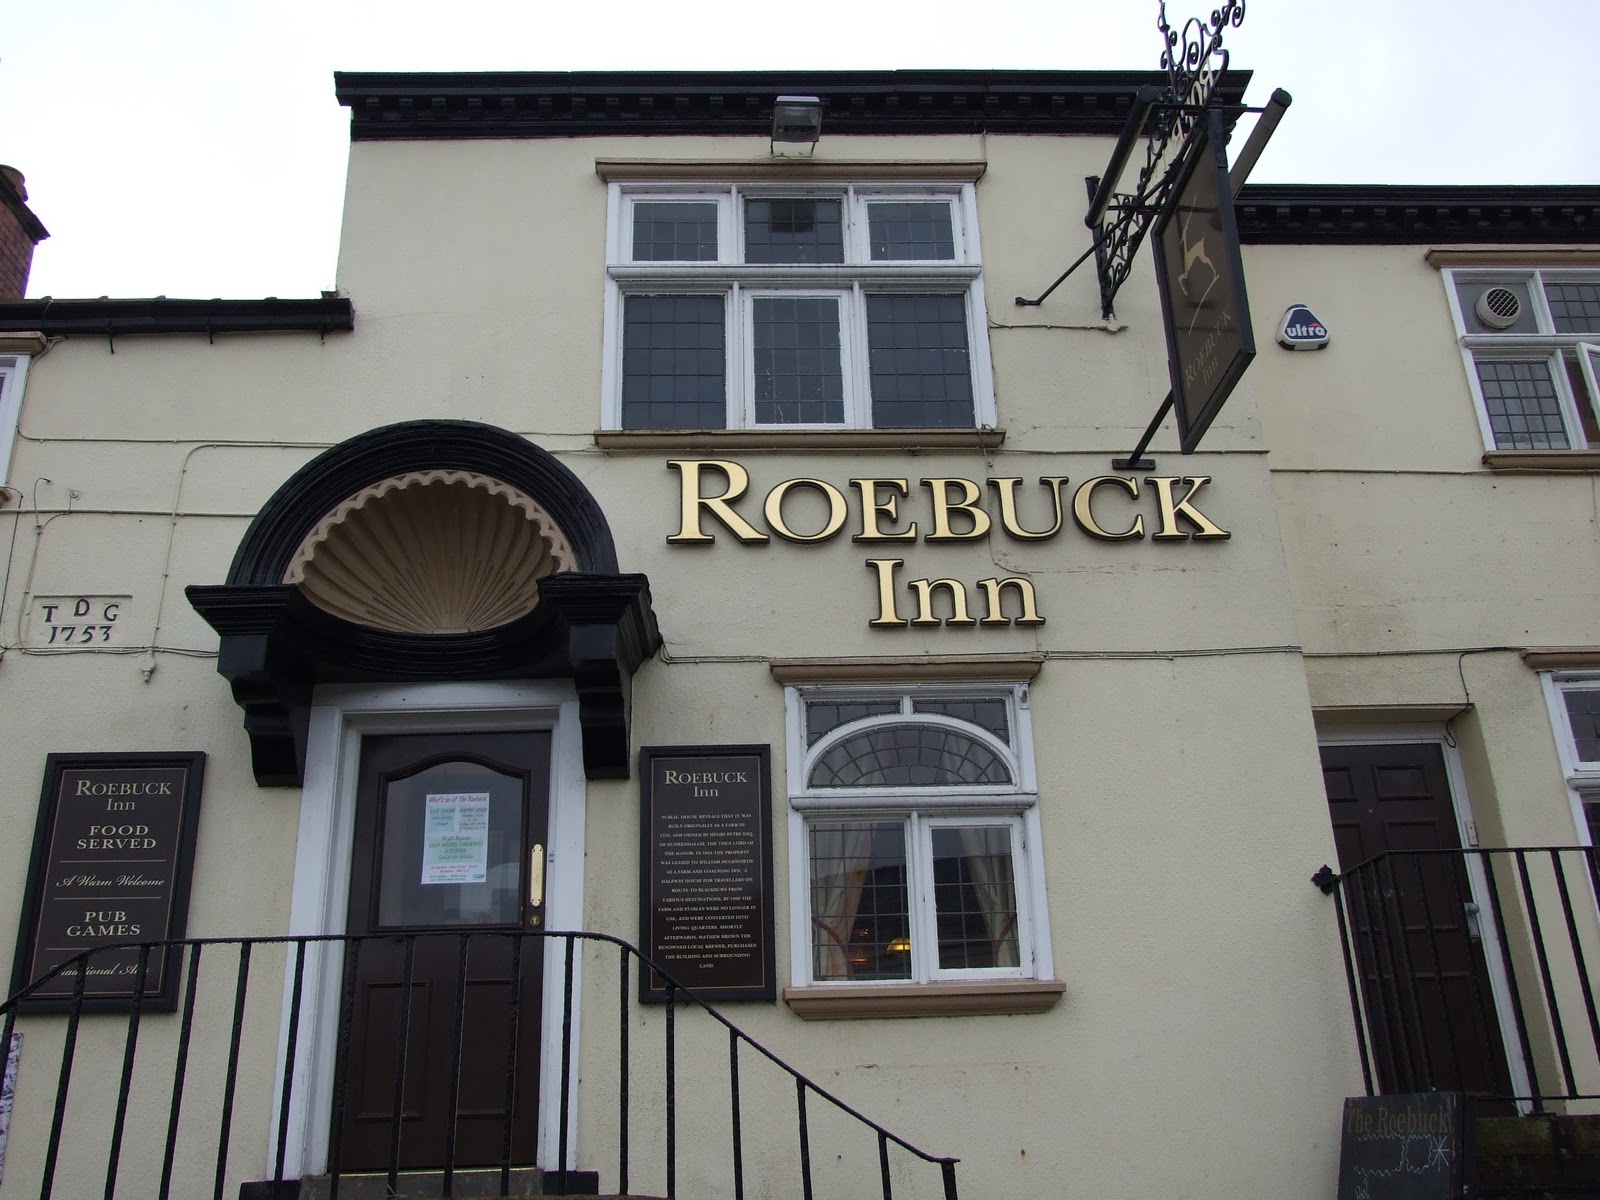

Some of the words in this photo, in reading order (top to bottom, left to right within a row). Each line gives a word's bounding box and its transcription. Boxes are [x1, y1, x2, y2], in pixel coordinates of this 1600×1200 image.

[1286, 323, 1326, 337] ultra
[666, 459, 1231, 545] ROEBUCK
[866, 558, 1046, 628] Inn
[42, 605, 59, 623] T
[74, 599, 90, 617] D
[103, 604, 119, 622] G
[48, 625, 112, 644] 1753
[664, 770, 748, 785] ROEBUCK
[75, 780, 172, 796] ROEBUCK
[693, 786, 719, 798] Inn
[106, 798, 136, 811] Inn
[89, 825, 149, 836] FOOD
[76, 838, 157, 850] SERVED
[56, 875, 77, 887] A
[76, 874, 113, 887] Warm
[116, 873, 165, 886] Welcome
[84, 911, 127, 923] PUB
[66, 924, 141, 937] GAMES
[1346, 1106, 1374, 1133] The
[1377, 1104, 1450, 1133] Roebuck
